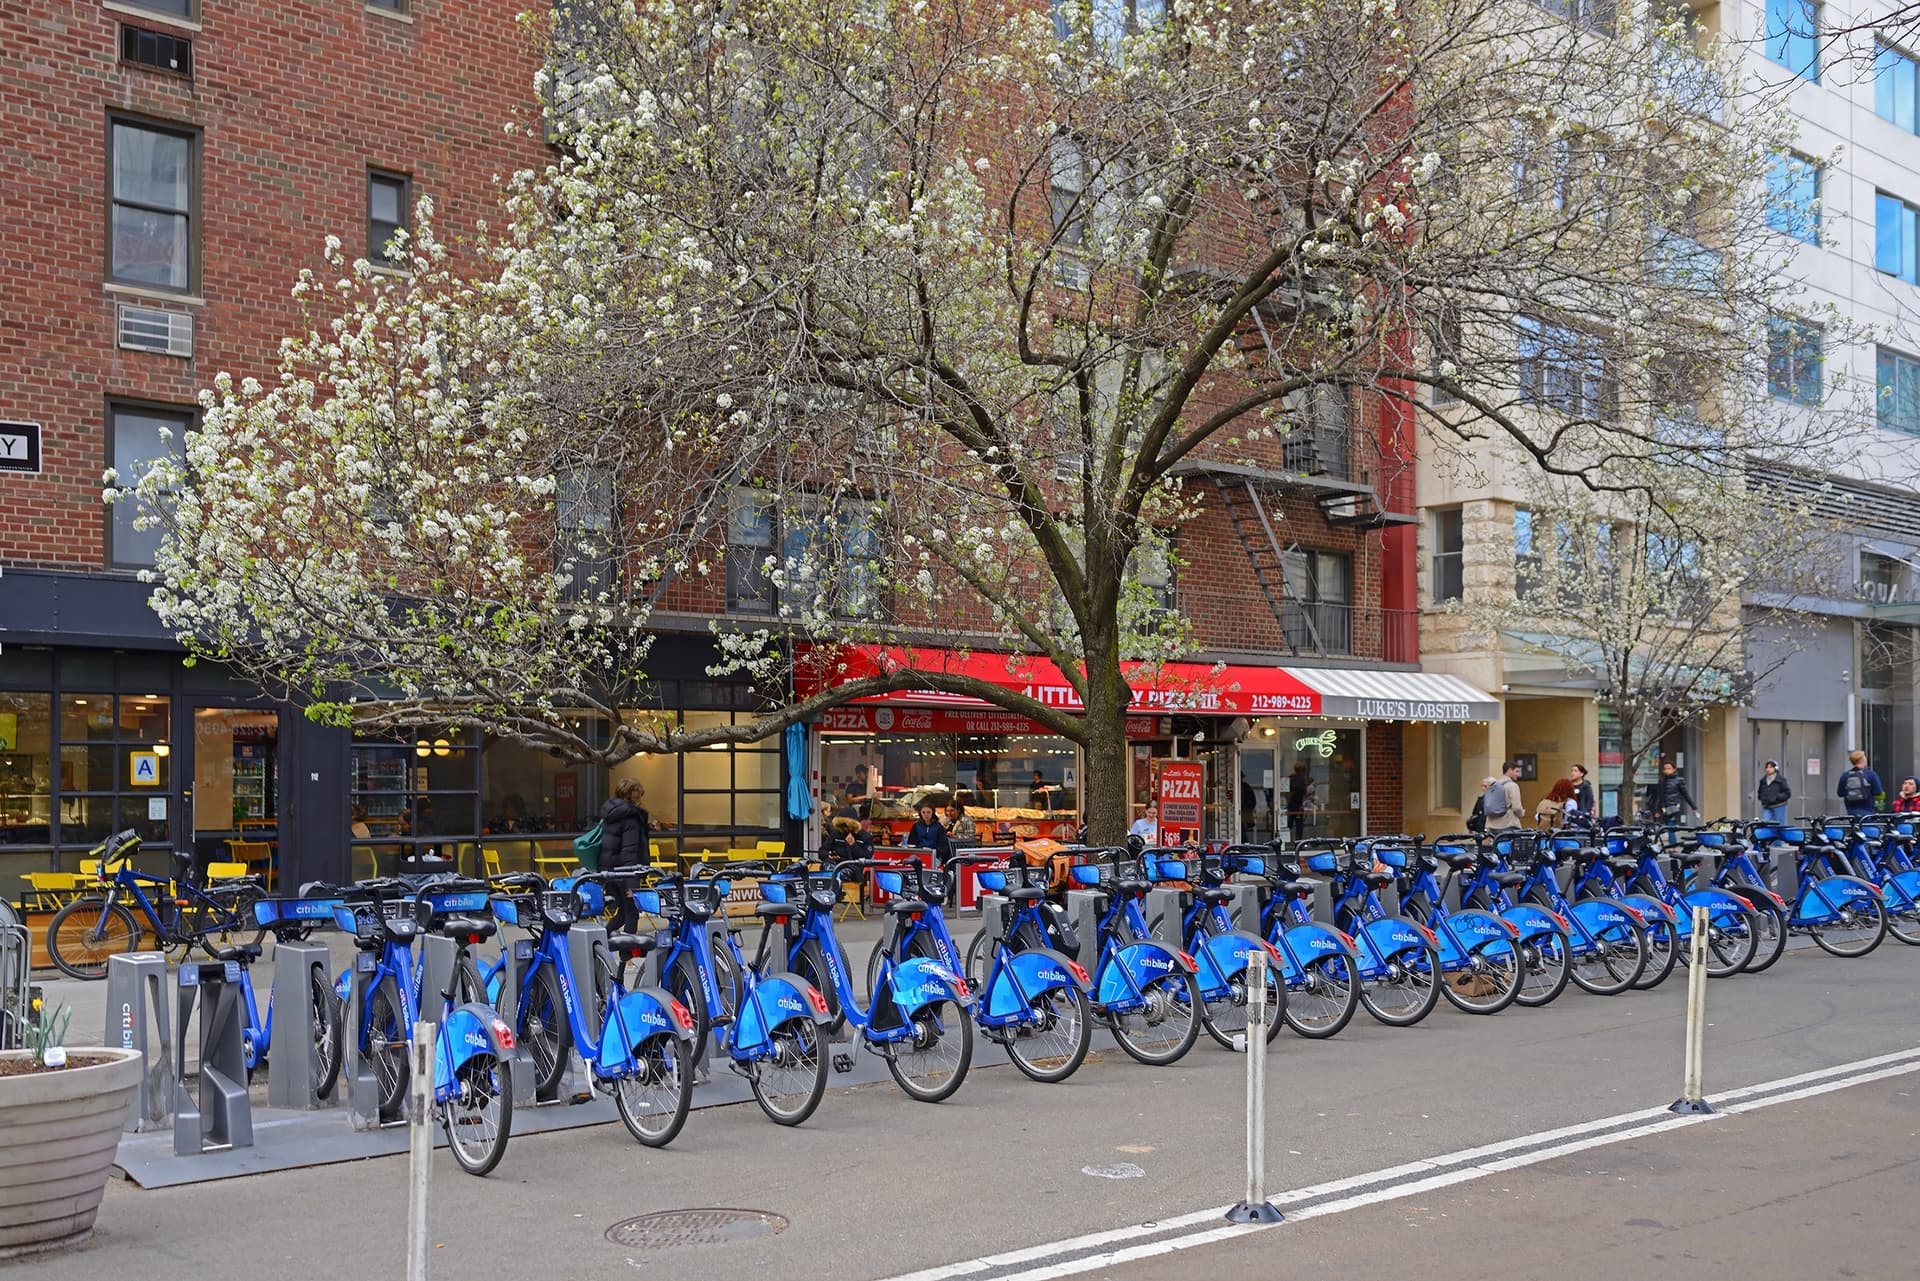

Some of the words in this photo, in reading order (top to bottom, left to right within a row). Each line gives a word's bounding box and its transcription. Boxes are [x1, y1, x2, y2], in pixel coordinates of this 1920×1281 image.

[0, 437, 17, 456] Y
[1026, 685, 1084, 705] LITTL
[1250, 694, 1312, 709] 212-989-4225
[1357, 699, 1407, 717] LUKE'S
[1409, 702, 1471, 719] LOBSTER
[823, 714, 869, 729] PIZZA
[901, 715, 933, 729] Coca-Cola
[976, 722, 989, 731] CALL
[137, 759, 153, 776] A
[1162, 779, 1200, 798] PIZZA
